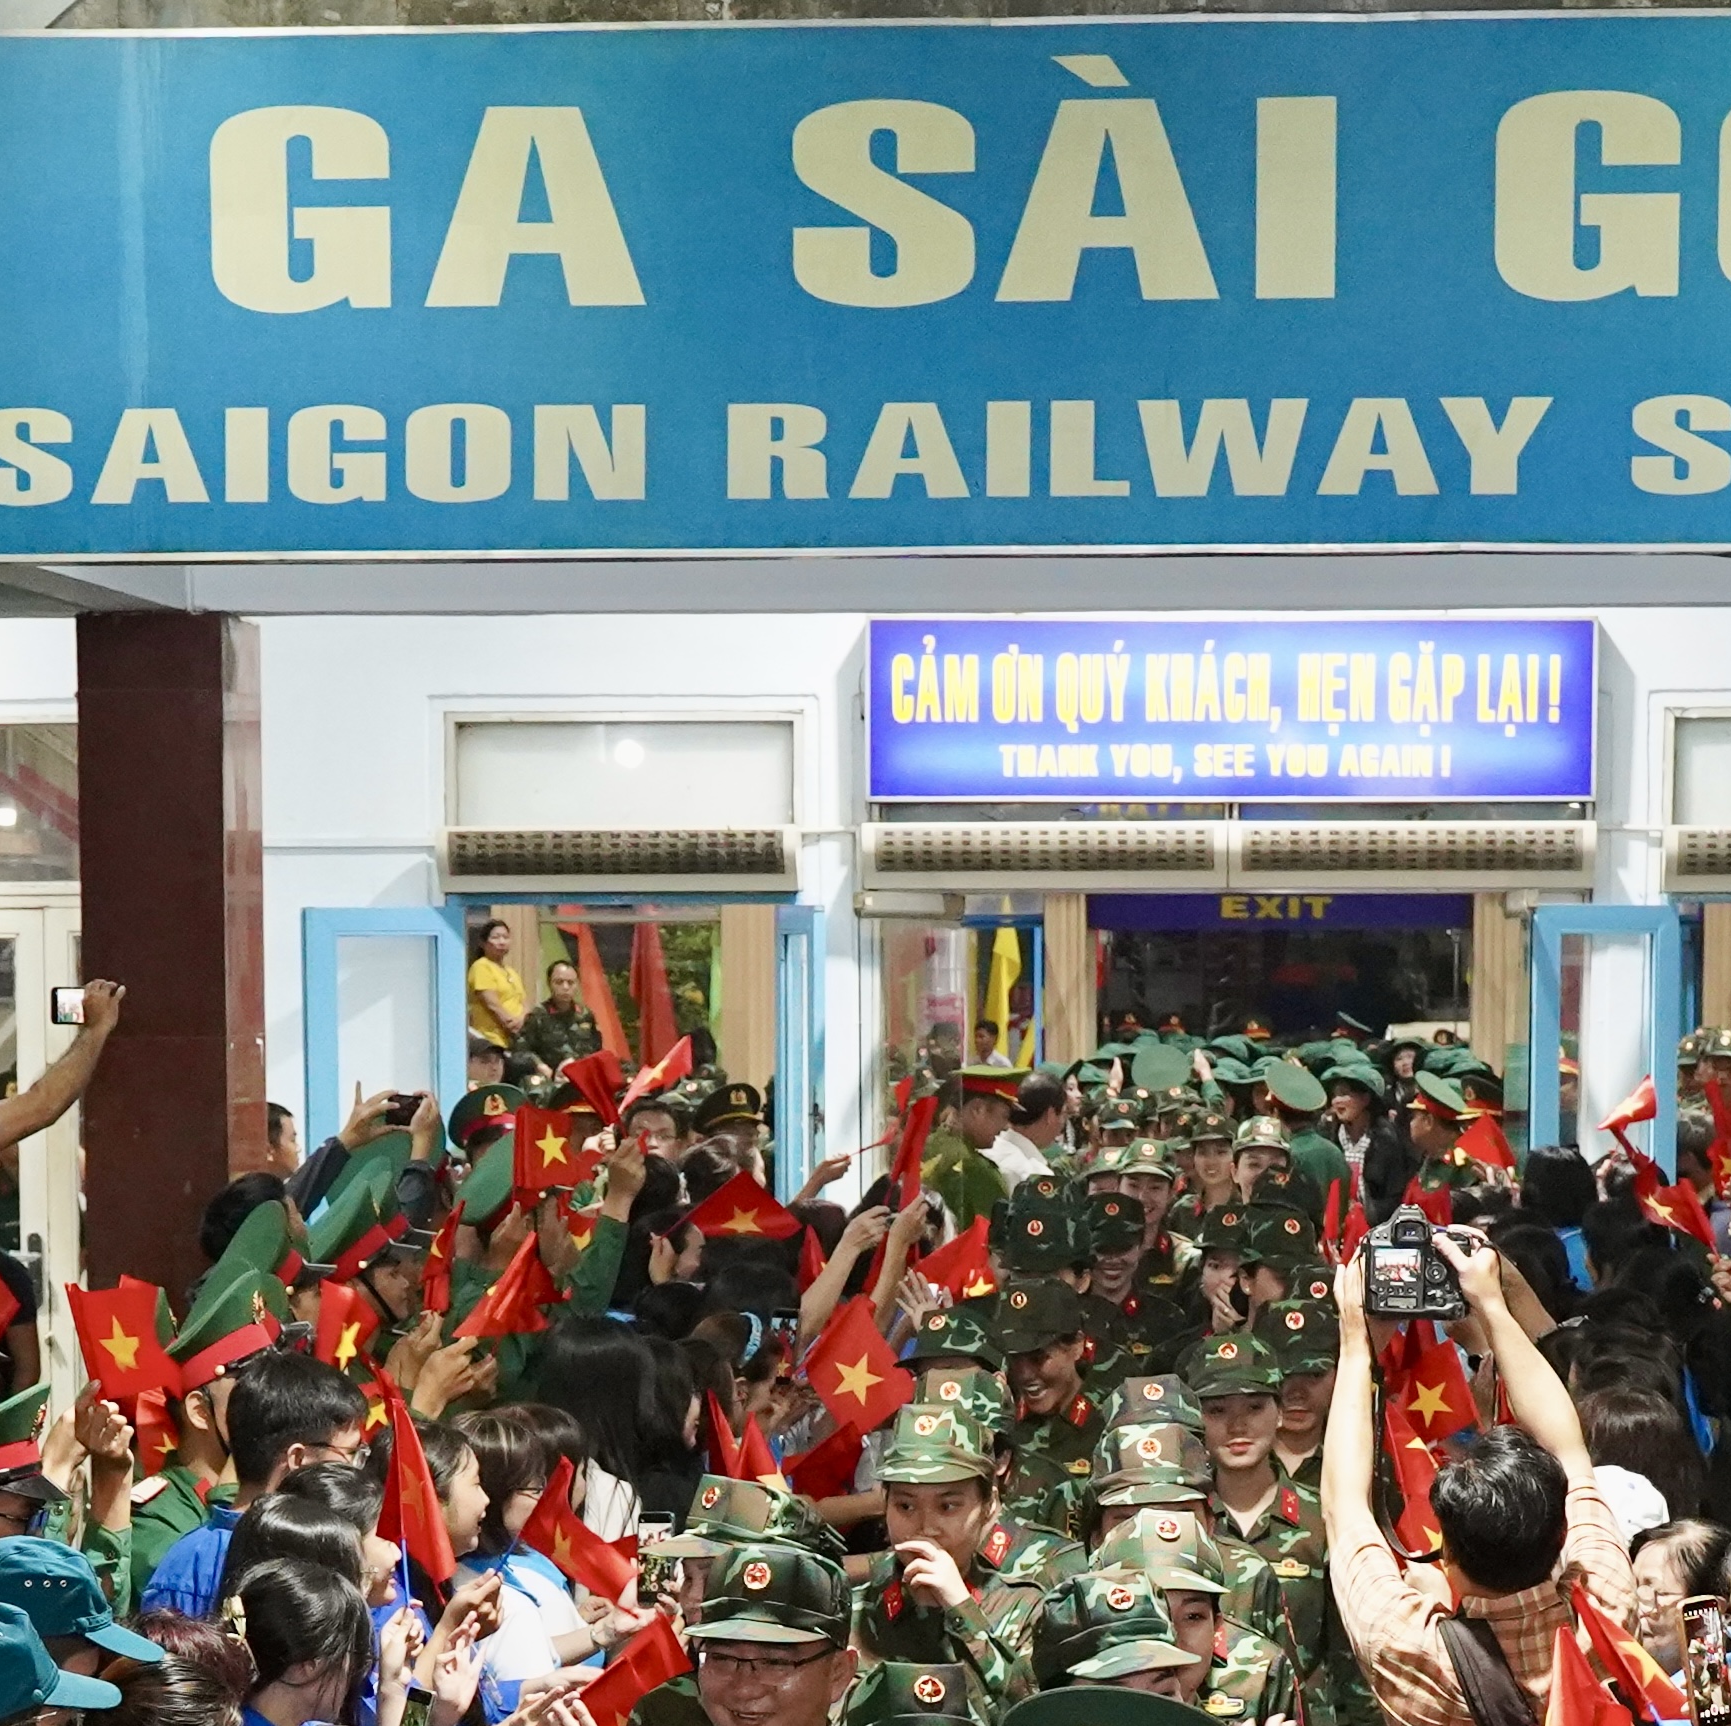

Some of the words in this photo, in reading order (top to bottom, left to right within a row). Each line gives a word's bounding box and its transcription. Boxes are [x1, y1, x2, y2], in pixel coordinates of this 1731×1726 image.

[209, 104, 645, 313] GA
[792, 54, 1338, 308] SÀI
[727, 397, 1552, 499] RAILWAY
[890, 635, 979, 723] CẢM
[991, 644, 1044, 723] ƠN
[1055, 640, 1131, 734] QUÝ
[1145, 640, 1282, 733] KHÁCH,
[1297, 653, 1377, 737] HẸN
[1387, 641, 1465, 737] GẶP
[999, 744, 1099, 778] THANK
[1110, 744, 1183, 784] YOU,
[1193, 744, 1255, 778] SEE
[1266, 744, 1329, 778] YOU
[1219, 895, 1333, 919] EXIT
